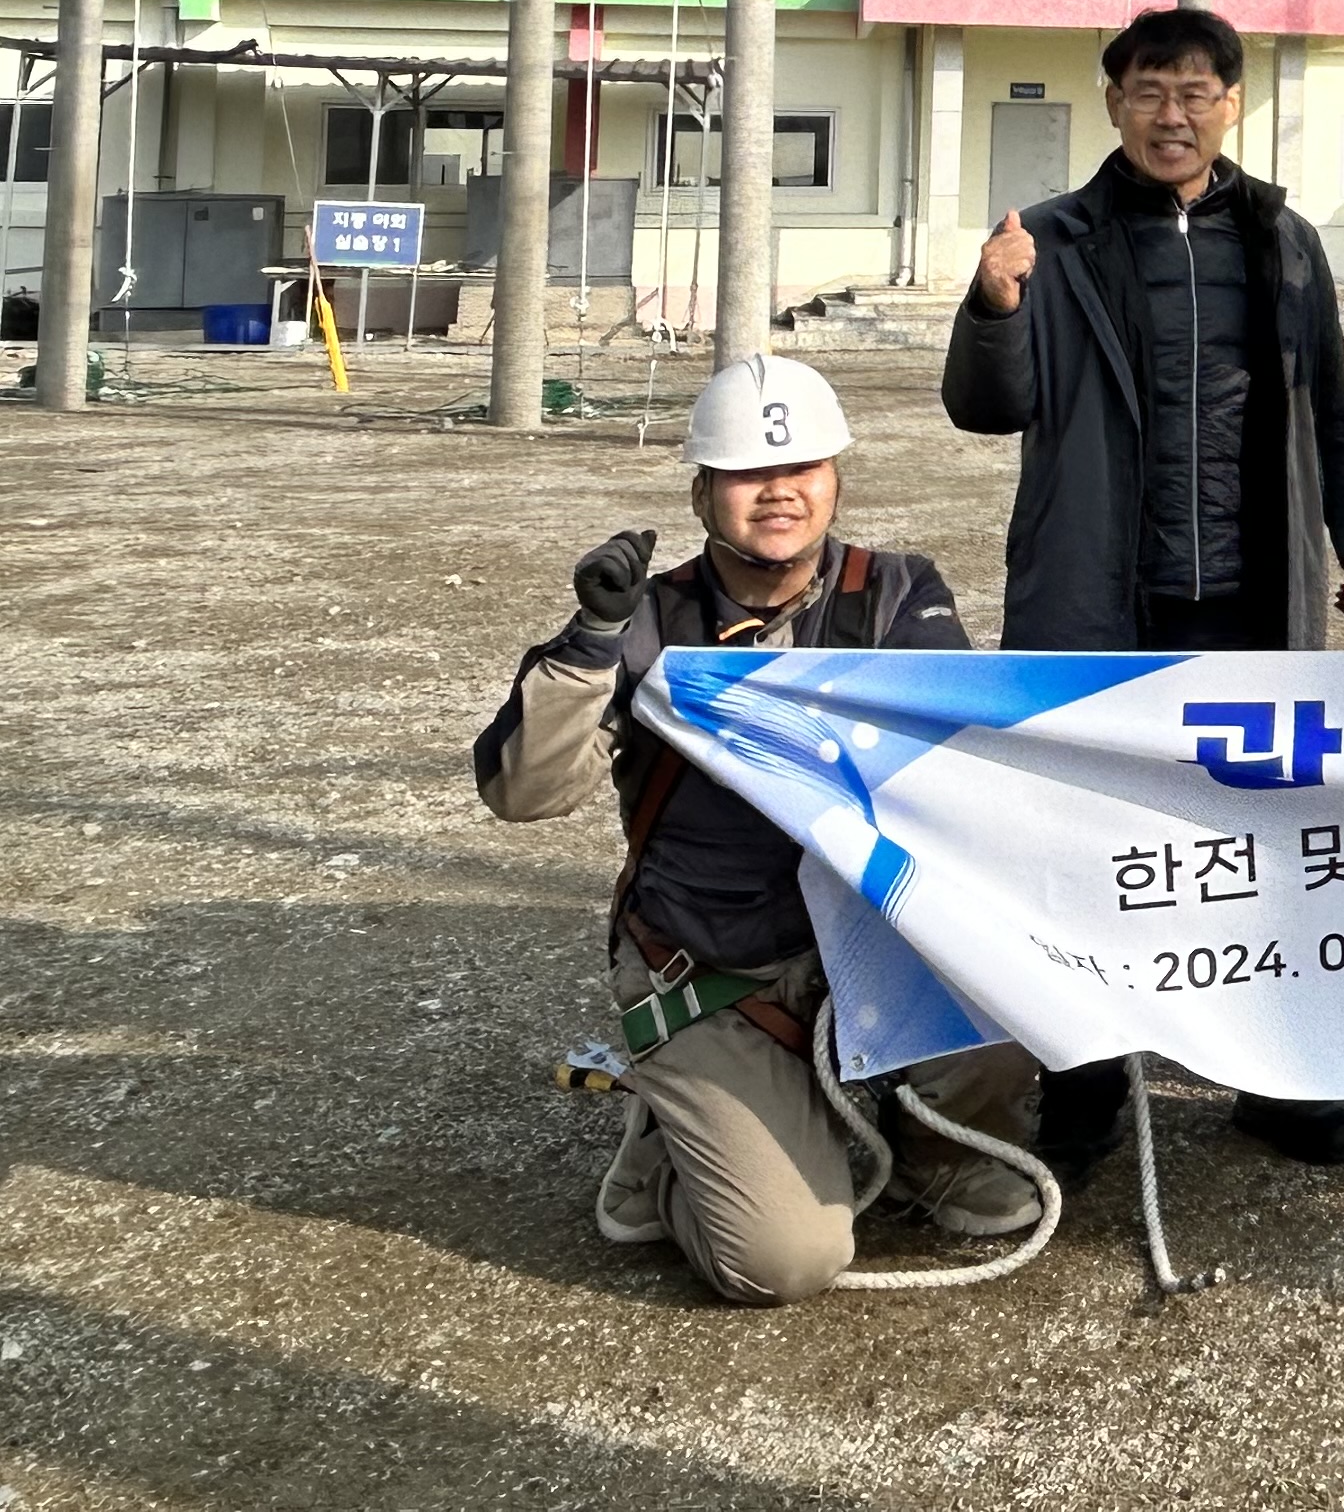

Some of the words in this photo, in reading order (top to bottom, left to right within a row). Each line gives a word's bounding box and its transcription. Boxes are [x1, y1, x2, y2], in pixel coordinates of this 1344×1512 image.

[762, 402, 793, 447] 3
[1111, 831, 1260, 912] 한전
[1152, 939, 1300, 992] 2024.
